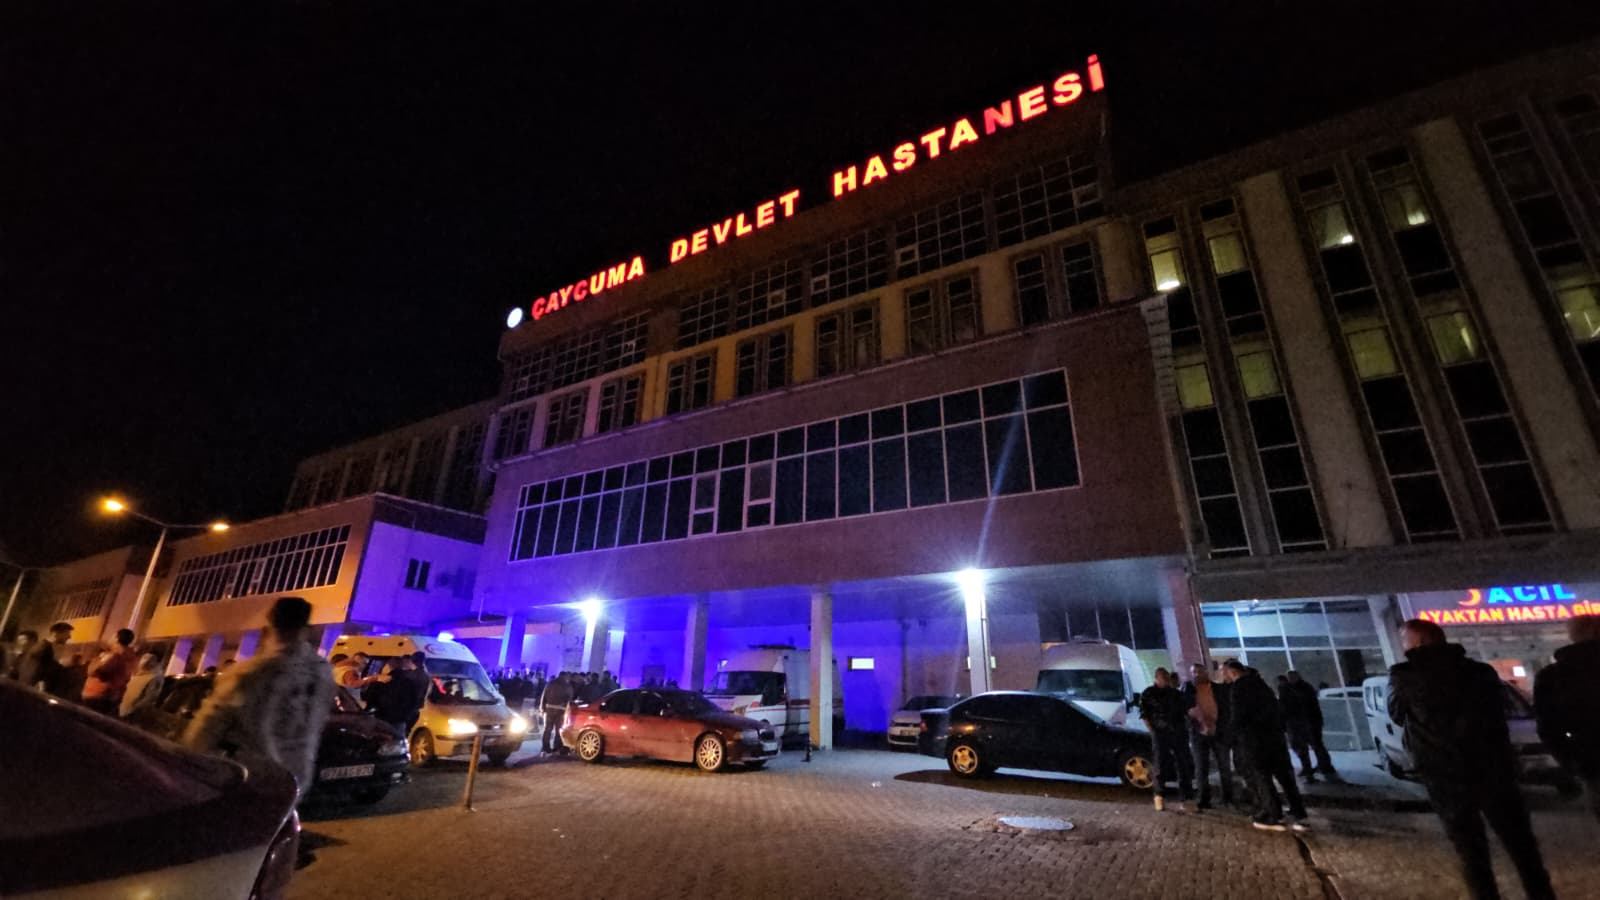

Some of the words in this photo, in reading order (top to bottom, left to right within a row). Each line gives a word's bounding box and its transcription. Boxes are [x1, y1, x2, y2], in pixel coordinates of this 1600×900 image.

[670, 189, 800, 263] DEVLET
[832, 54, 1105, 197] HASTANESİ
[1417, 606, 1505, 624] AYAKTAN
[1507, 604, 1571, 621] HASTA
